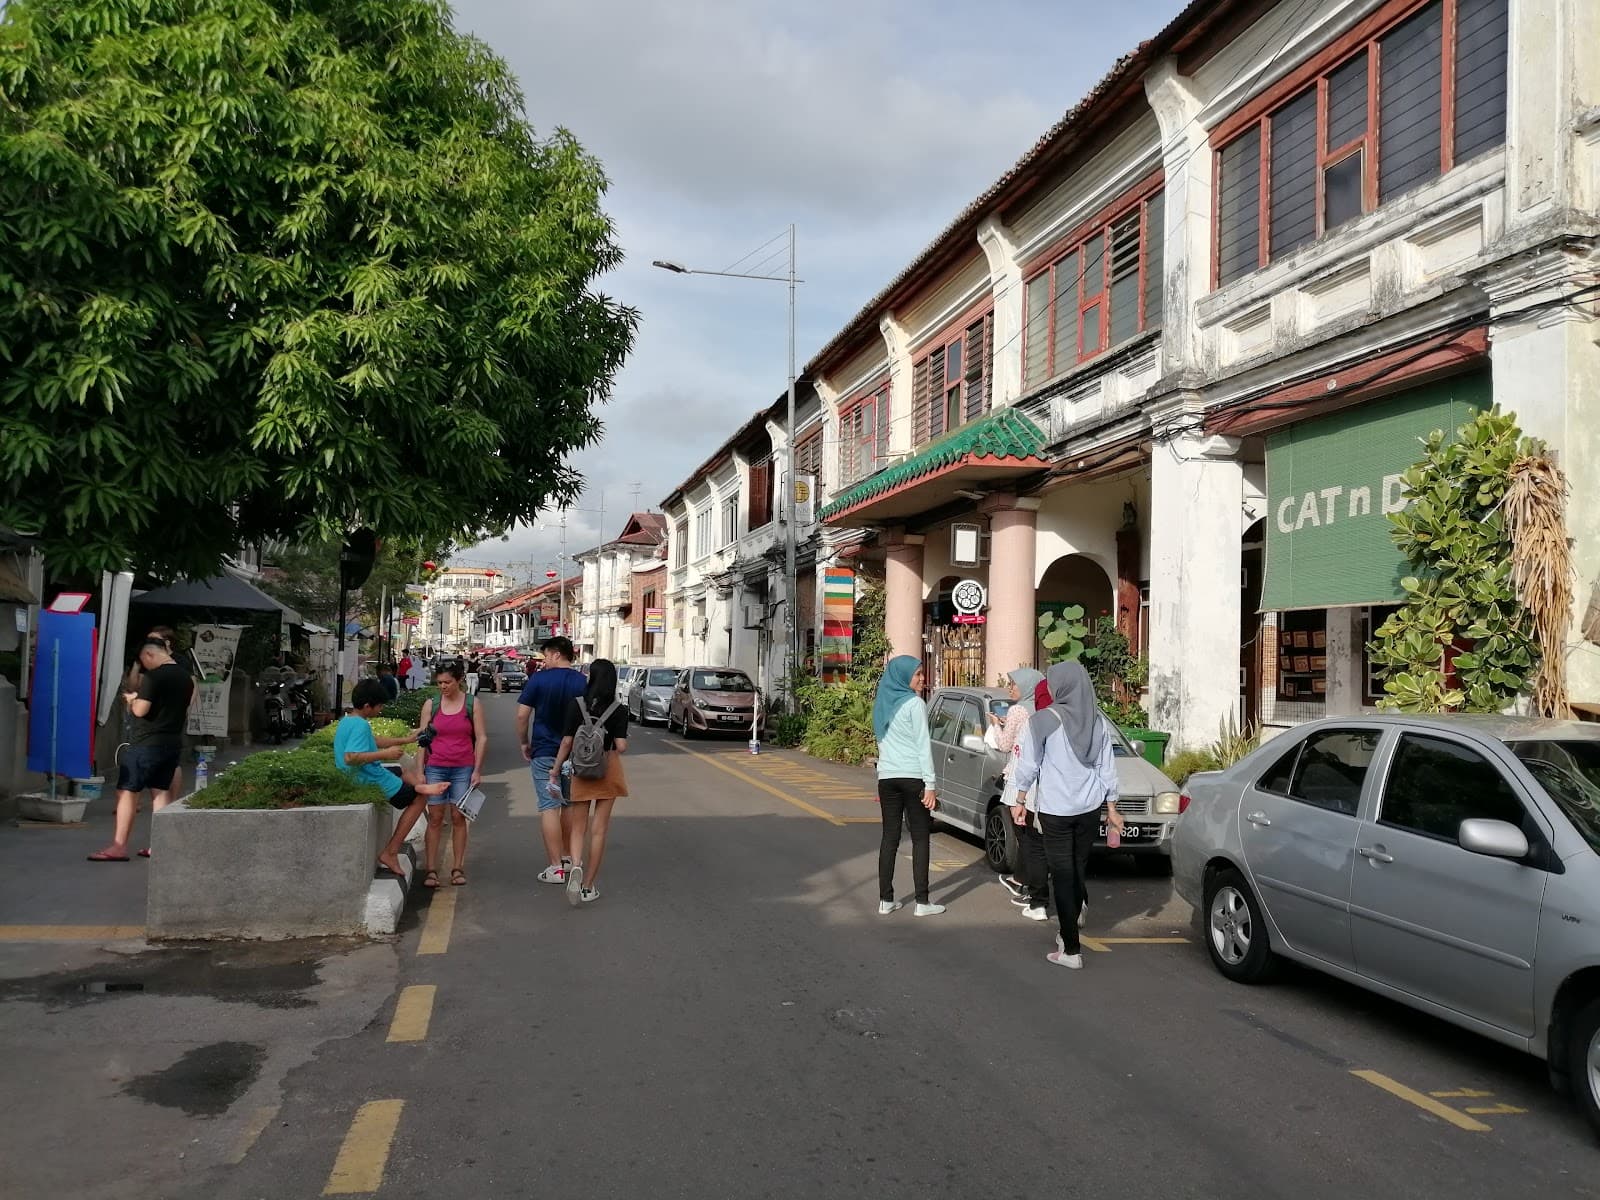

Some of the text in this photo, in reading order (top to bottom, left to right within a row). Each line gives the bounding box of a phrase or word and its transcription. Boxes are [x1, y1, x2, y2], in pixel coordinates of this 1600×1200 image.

[1277, 473, 1416, 533] CAT n D
